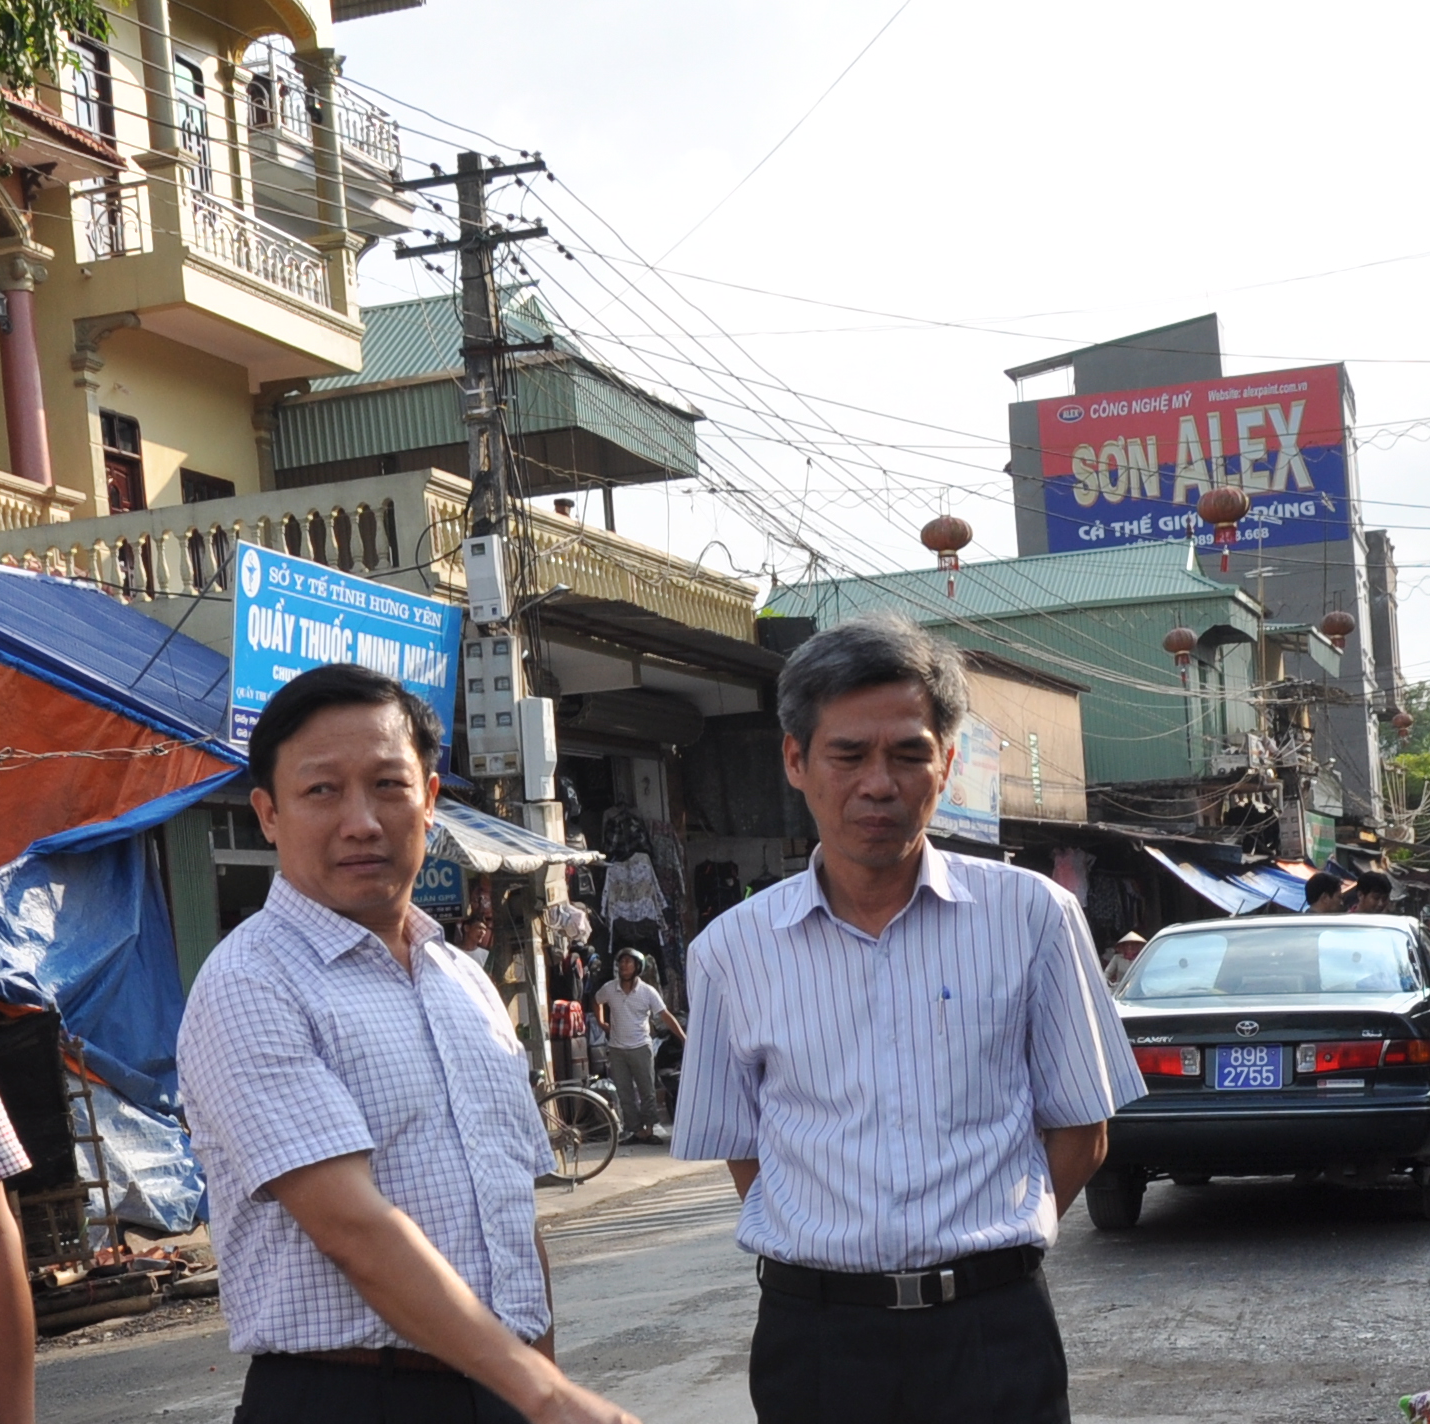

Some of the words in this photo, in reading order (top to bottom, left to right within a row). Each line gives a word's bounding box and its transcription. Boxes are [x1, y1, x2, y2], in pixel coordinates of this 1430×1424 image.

[1090, 400, 1128, 419] CÔNG
[1132, 393, 1169, 414] NGHỆ
[1172, 389, 1192, 409] MỸ
[1072, 435, 1161, 507] SƠN
[1173, 400, 1314, 504] ALEX
[1078, 519, 1105, 541] CẢ
[1110, 512, 1153, 537] THẾ
[269, 562, 290, 586] SỞ
[293, 572, 306, 590] Y
[307, 574, 328, 598] TẾ
[330, 580, 367, 607] TỈNH
[369, 595, 410, 620] HƯNG
[412, 606, 443, 628] YÊN
[247, 597, 296, 652] QUẦY
[299, 613, 354, 664] THUỐC
[357, 632, 401, 679] MINH
[403, 641, 448, 689] NHÀN
[1230, 1046, 1268, 1066] 89B
[1223, 1066, 1275, 1087] 2755
